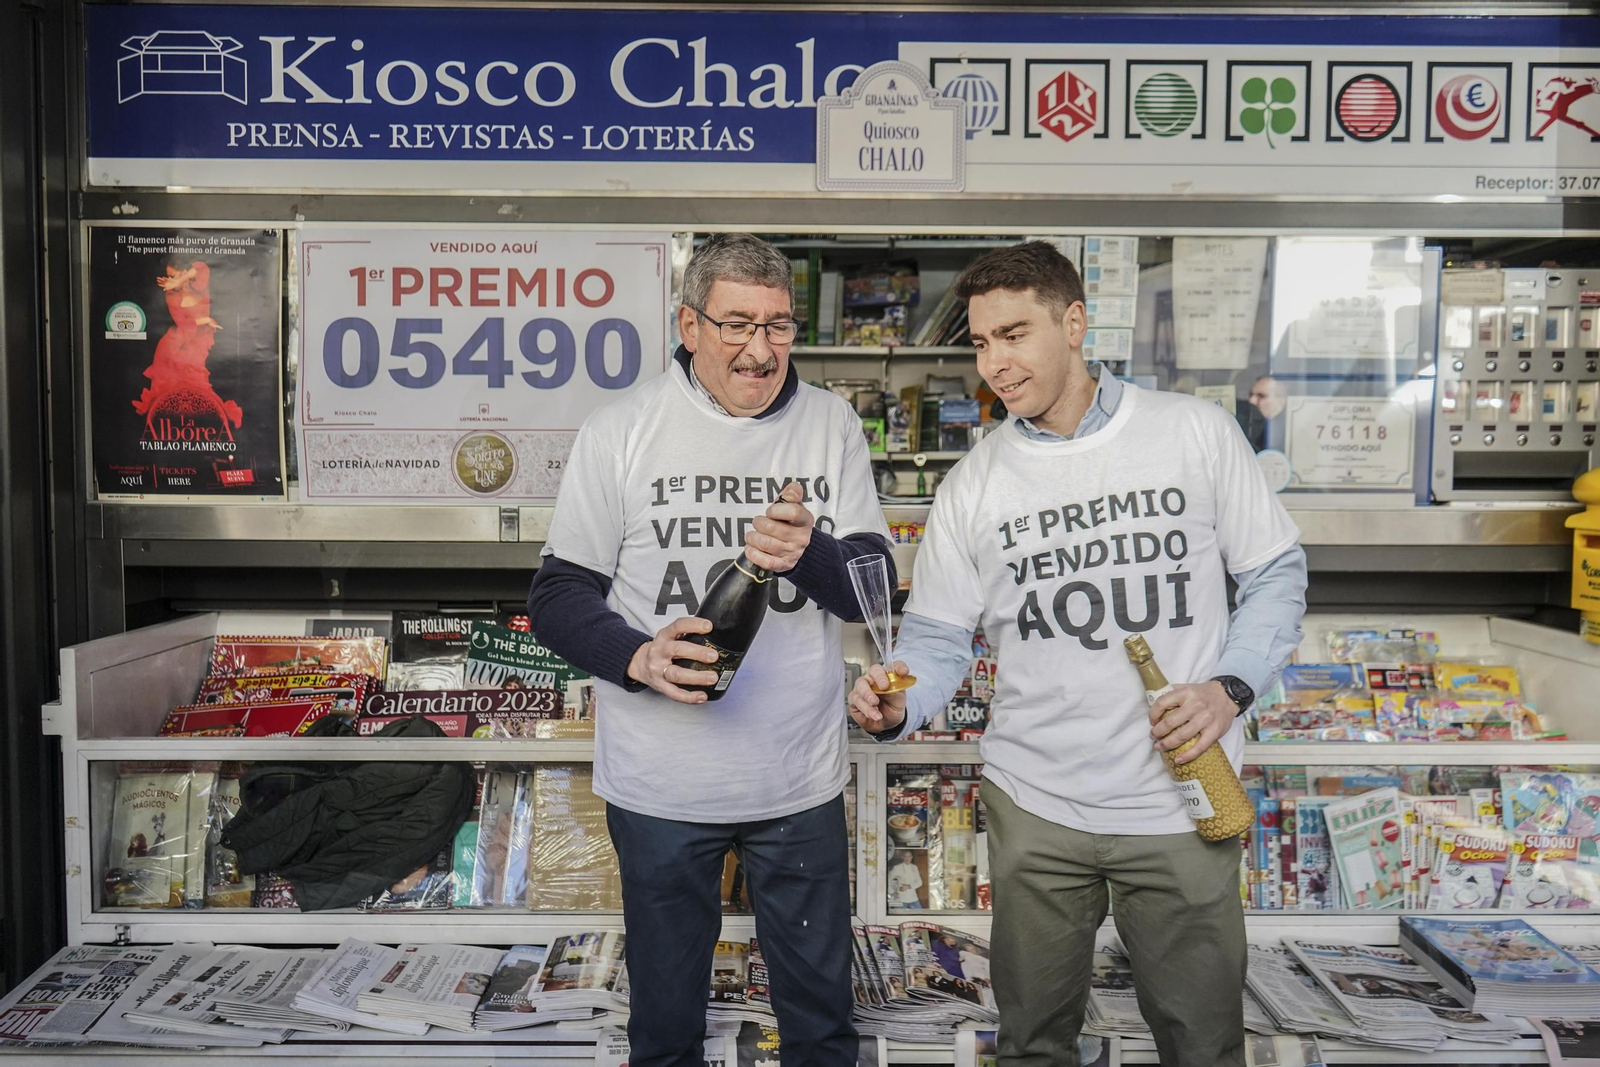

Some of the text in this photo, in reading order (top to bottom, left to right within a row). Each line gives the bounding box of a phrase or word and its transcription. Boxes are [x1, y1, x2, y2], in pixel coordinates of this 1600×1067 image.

[259, 36, 577, 107] Kiosco
[227, 123, 363, 148] PRENSA
[388, 123, 555, 150] REVISTAS
[582, 119, 755, 152] LOTERÍAS
[863, 121, 920, 143] Quiosco
[859, 147, 924, 171] CHALO
[1475, 175, 1554, 192] Receptor:
[118, 235, 256, 246] El flamenco más puro de Granada
[429, 240, 538, 254] VENDIDO AQUÍ
[127, 245, 246, 255] The purest flamenco of Granada
[392, 267, 615, 308] PREMIO
[322, 316, 642, 390] 05490
[180, 415, 195, 427] La
[140, 441, 236, 452] TABLAO FLAMENCO
[1361, 443, 1381, 452] AQUÍ
[160, 467, 197, 475] TICKETS
[547, 461, 561, 469] 22
[120, 475, 143, 485] AQUÍ
[167, 478, 191, 486] HERE
[1038, 488, 1186, 538] PREMIO
[1006, 530, 1188, 586] VENDIDO
[1017, 563, 1194, 650] AQUÍ
[493, 638, 552, 658] THE BODY
[500, 654, 514, 662] bath
[516, 656, 534, 666] blend
[366, 691, 554, 716] Calendario 2023
[122, 789, 179, 805] AUDIOCUENTOS
[1456, 835, 1508, 851] SUDOKU
[1526, 836, 1576, 849] SUDOKU
[1295, 940, 1370, 955] Granada
